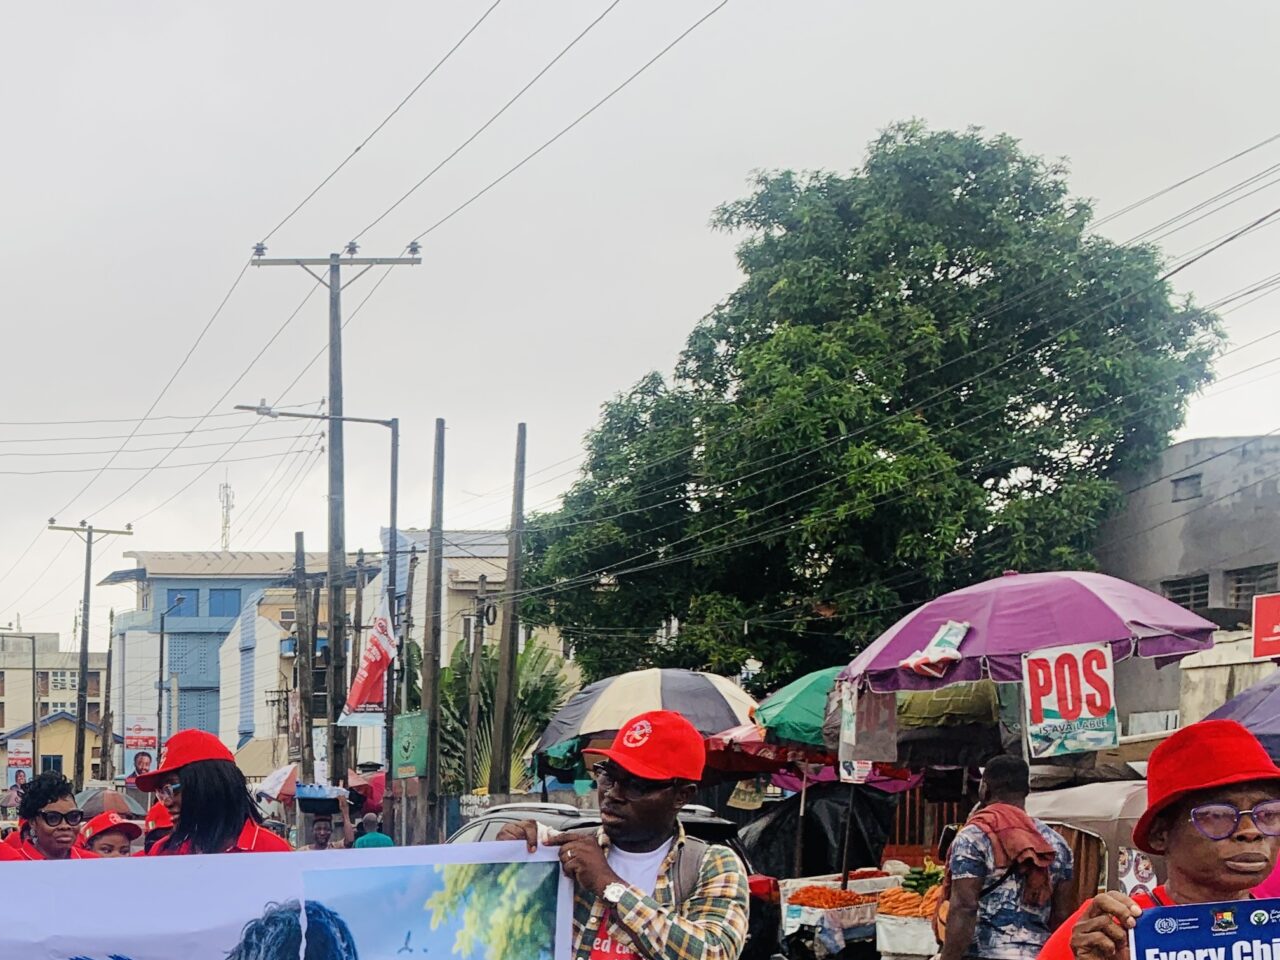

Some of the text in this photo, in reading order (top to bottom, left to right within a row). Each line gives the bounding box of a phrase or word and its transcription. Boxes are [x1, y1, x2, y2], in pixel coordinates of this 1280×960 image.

[1027, 649, 1111, 725] POS
[1040, 720, 1108, 735] IS AVAILABLE
